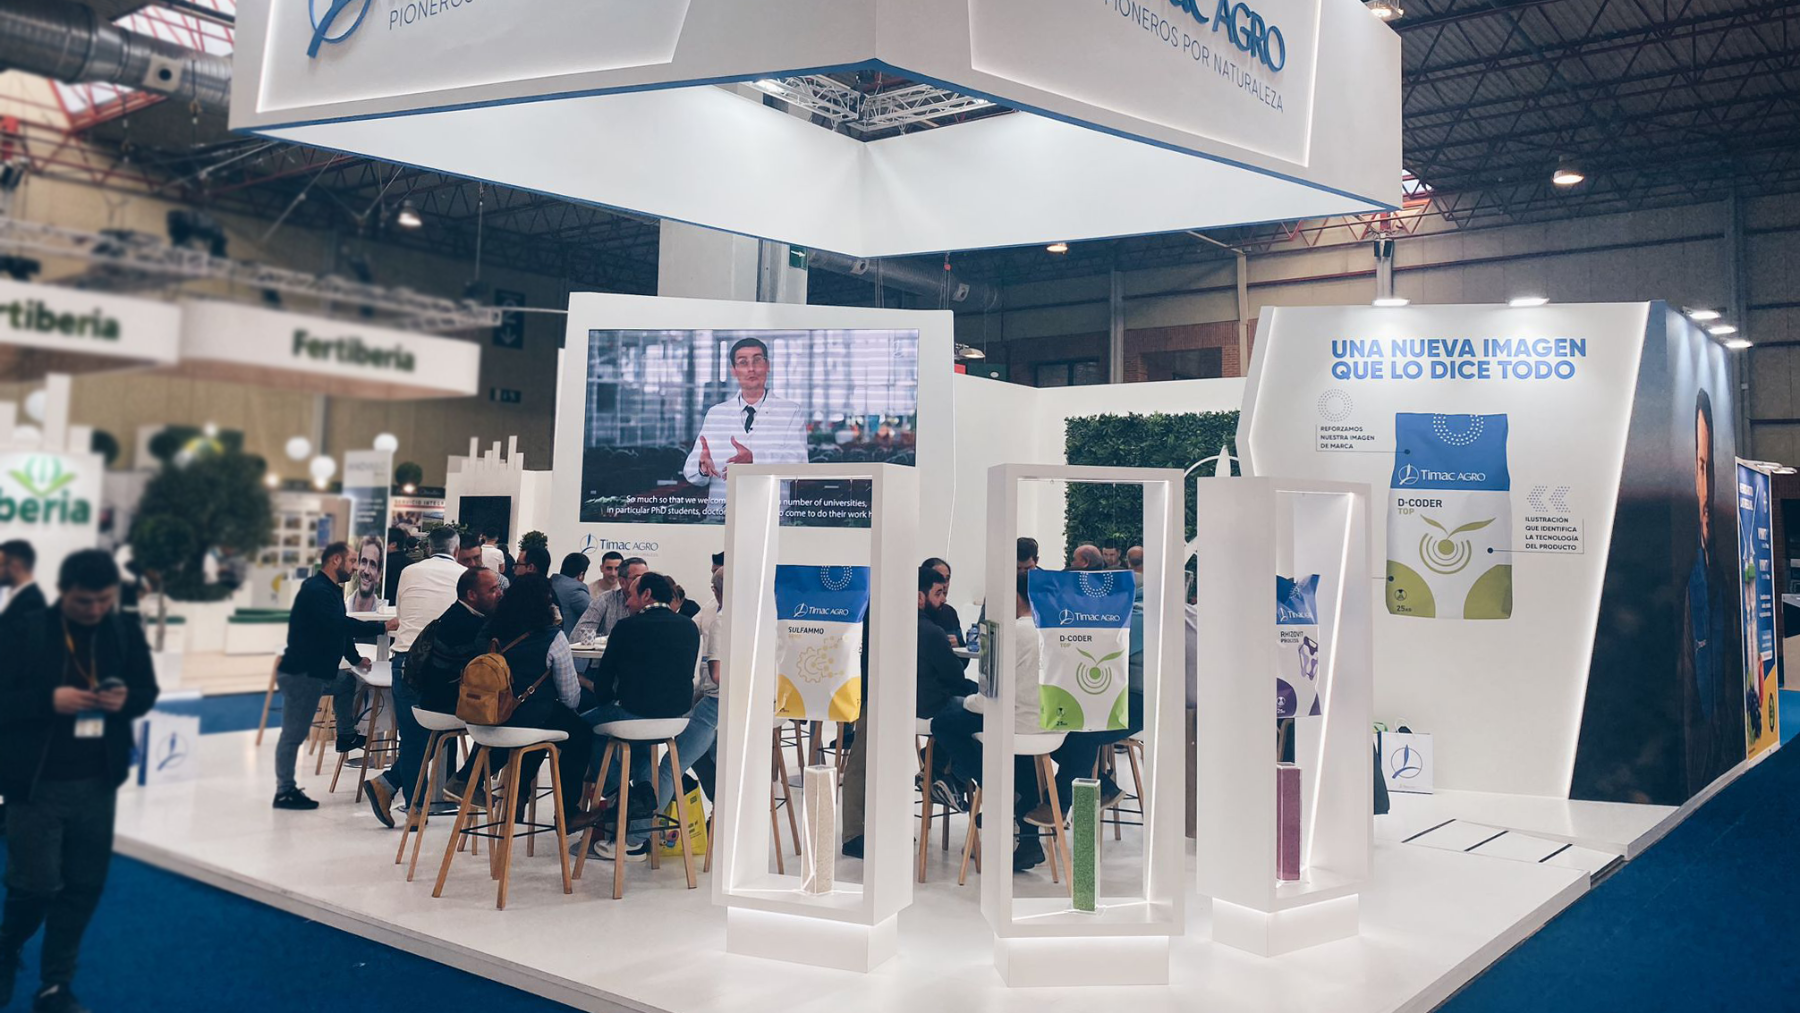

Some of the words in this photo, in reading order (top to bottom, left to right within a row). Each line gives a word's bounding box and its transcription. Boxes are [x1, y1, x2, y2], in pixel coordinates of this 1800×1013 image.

[389, 0, 473, 30] PIONER
[1211, 0, 1286, 73] AGRO
[1183, 33, 1210, 68] POR
[1213, 53, 1284, 114] NATURALEZA
[293, 328, 415, 373] Fertiberia
[1331, 339, 1384, 358] UNA
[1391, 338, 1476, 358] NUEVA
[1483, 338, 1586, 357] IMAGEN
[1331, 360, 1383, 380] QUE
[1391, 360, 1423, 380] LO
[1430, 360, 1490, 380] DICE
[1497, 360, 1575, 380] TODO
[1420, 469, 1455, 481] Timac
[1457, 472, 1486, 482] AGRO
[626, 495, 635, 503] So
[637, 495, 658, 503] much
[669, 495, 684, 504] that
[783, 498, 812, 506] number
[814, 498, 823, 506] of
[823, 499, 868, 508] universities,
[1397, 498, 1443, 508] D-CODER
[615, 507, 650, 516] particular
[651, 506, 667, 514] PhD
[667, 507, 700, 516] students,
[817, 510, 827, 518] do
[828, 510, 846, 518] their
[600, 539, 630, 550] Timac
[632, 542, 659, 551] AGRO
[808, 606, 830, 615] Timac
[830, 608, 849, 616] AGRO
[1074, 612, 1099, 621] Timac
[1101, 614, 1121, 622] AGRO
[788, 626, 825, 635] SULFAMMO
